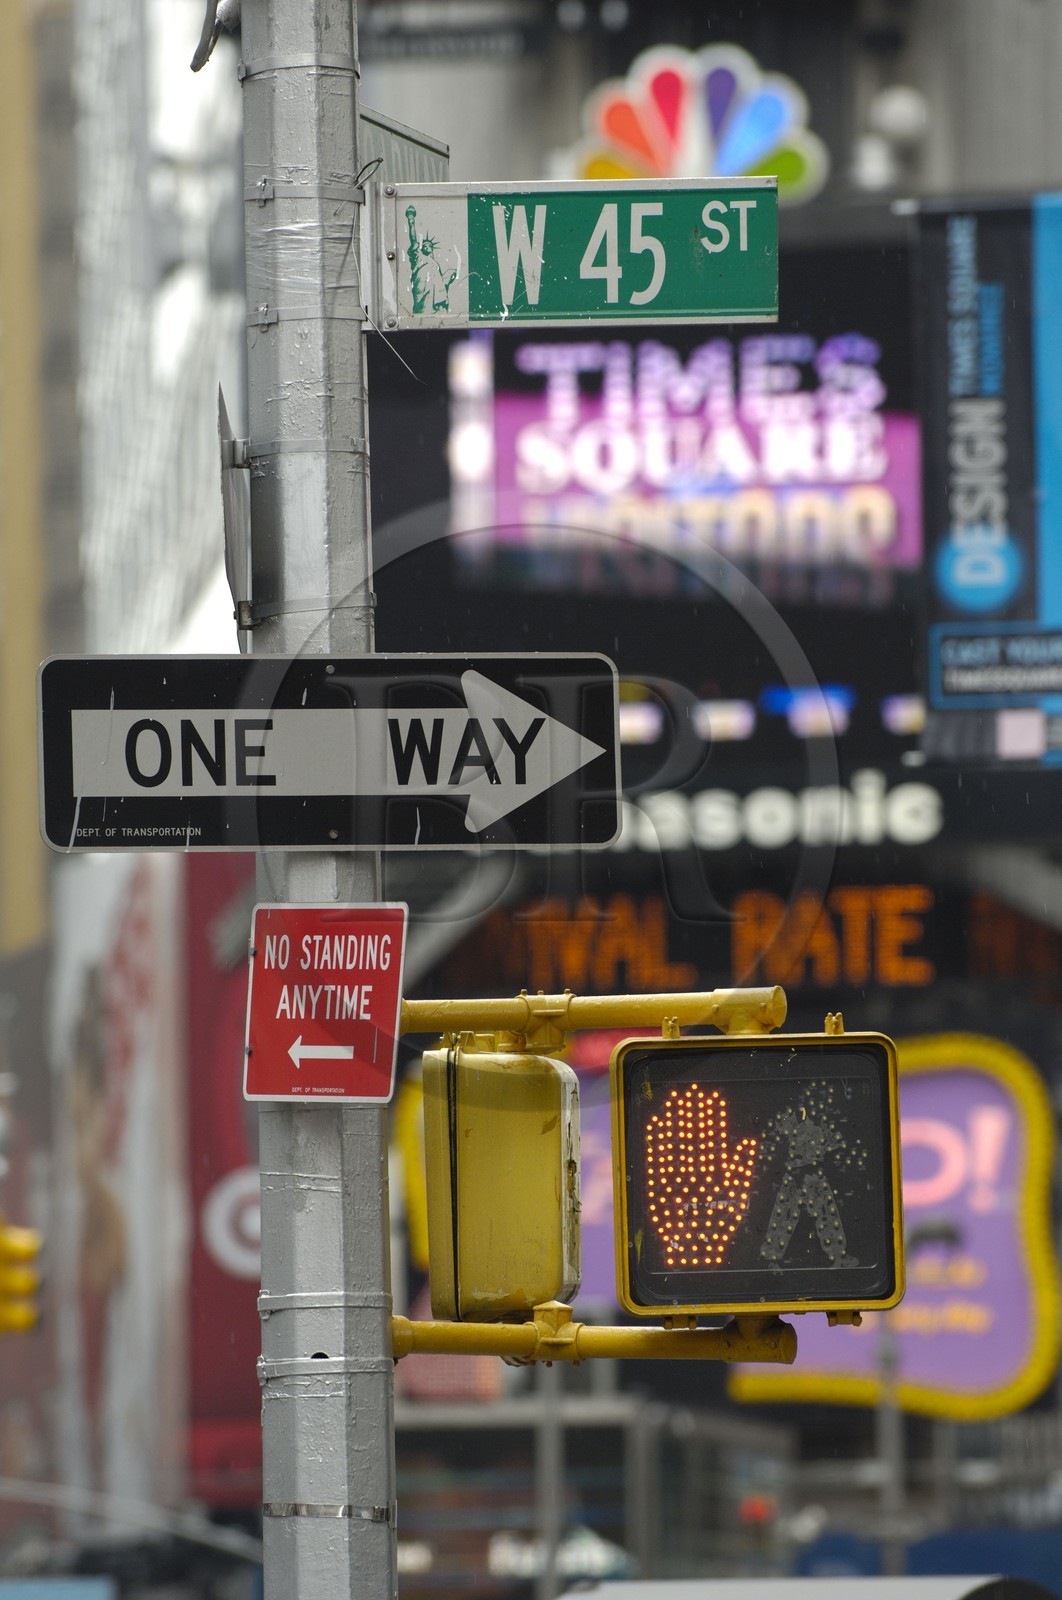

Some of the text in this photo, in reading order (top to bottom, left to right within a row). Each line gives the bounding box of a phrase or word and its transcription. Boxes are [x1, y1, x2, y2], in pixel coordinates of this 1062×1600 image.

[492, 200, 757, 306] W 45 ST
[514, 333, 886, 430] TIMES
[949, 396, 1006, 586] DESIGN
[124, 717, 546, 787] ONE WAY
[76, 827, 202, 837] DEPT. OF TRANSPORTATION
[612, 767, 943, 853] asonic
[264, 934, 392, 971] NO STANDING
[731, 883, 936, 988] RATE
[275, 985, 373, 1020] ANYTIME
